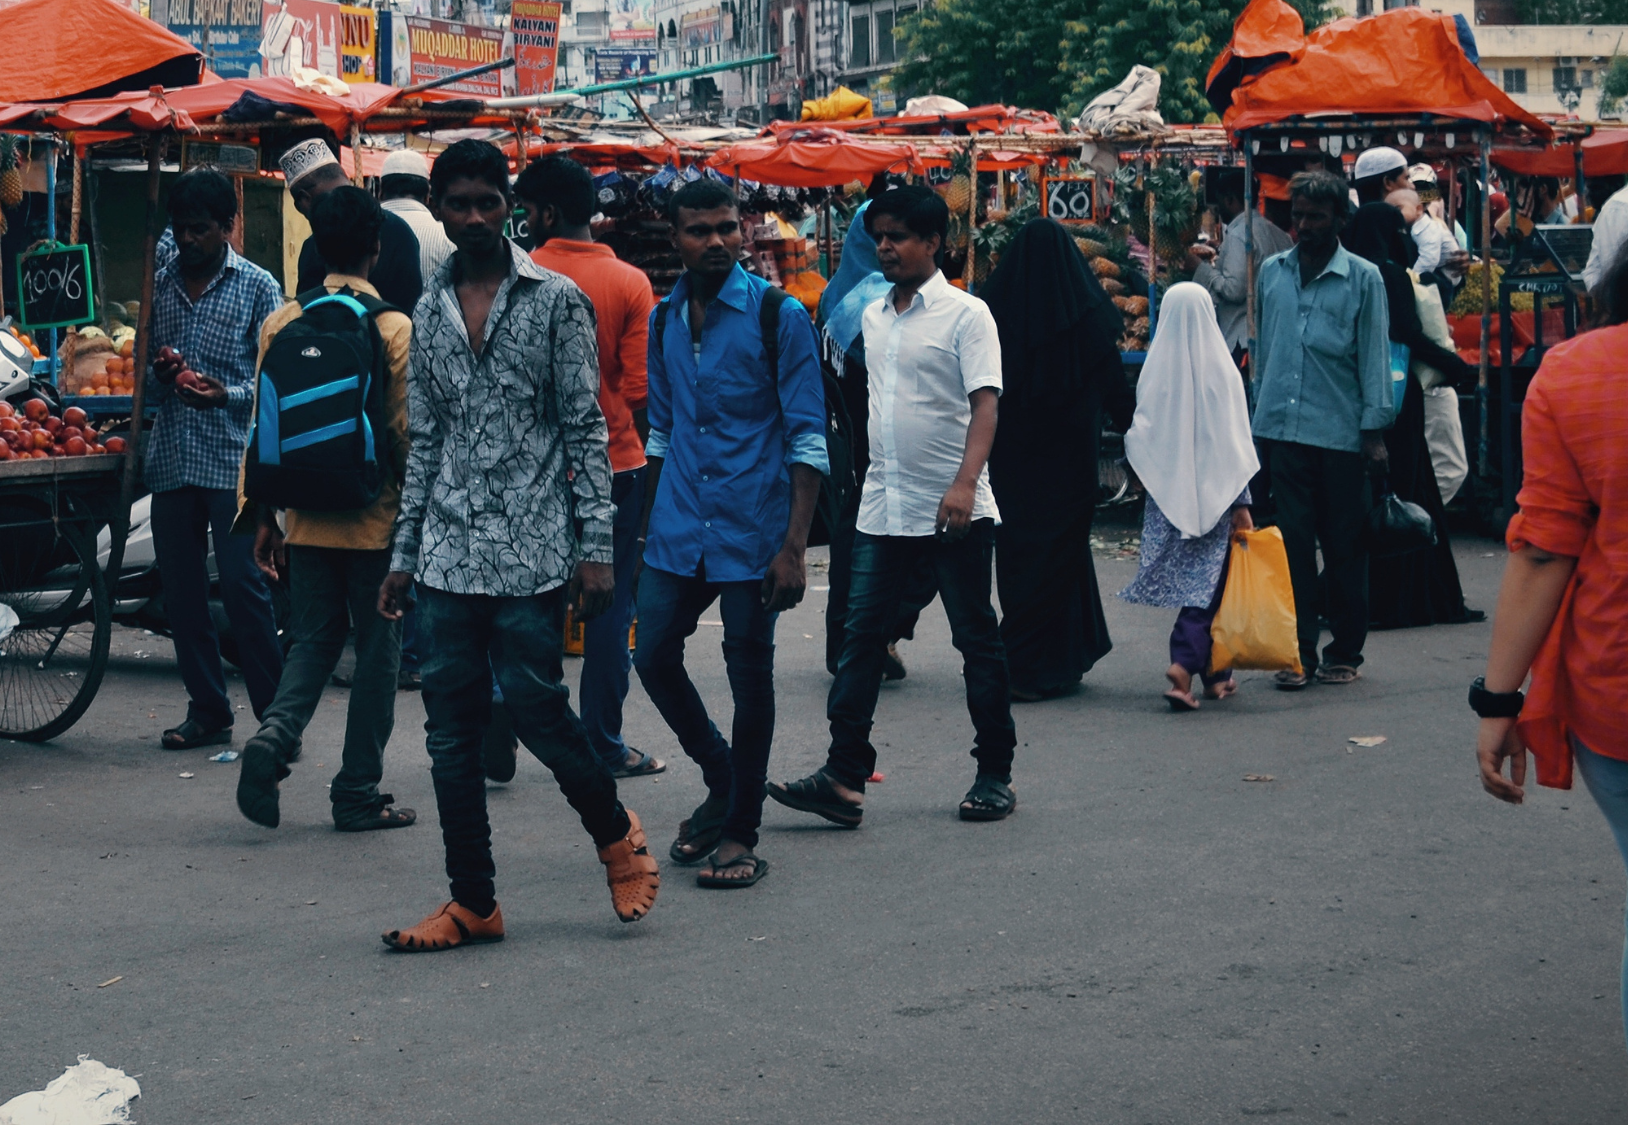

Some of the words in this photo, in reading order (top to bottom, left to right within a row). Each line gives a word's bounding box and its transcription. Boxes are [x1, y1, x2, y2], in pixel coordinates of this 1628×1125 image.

[542, 5, 559, 18] HOTEL
[514, 18, 556, 33] KALYANI
[411, 28, 468, 62] MUQADDAR
[470, 36, 498, 64] HOTEL
[514, 33, 555, 48] BIRYANI
[1048, 182, 1091, 220] 60
